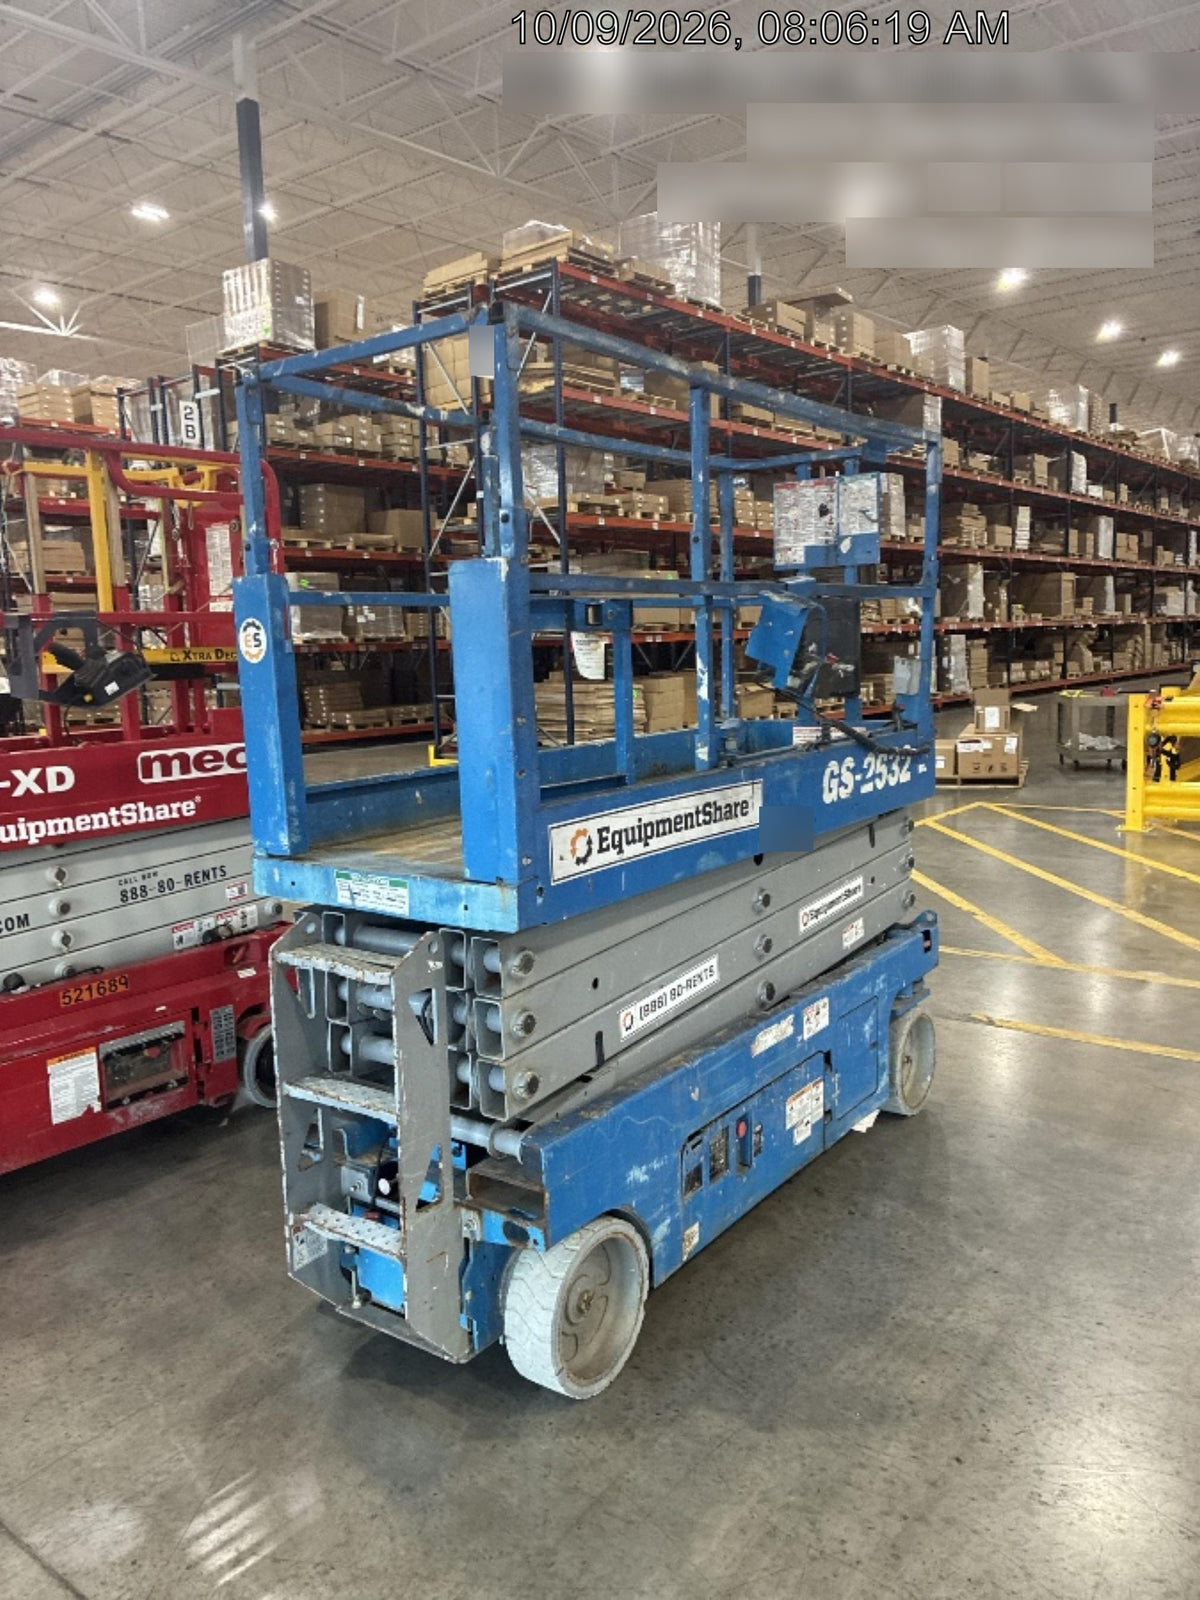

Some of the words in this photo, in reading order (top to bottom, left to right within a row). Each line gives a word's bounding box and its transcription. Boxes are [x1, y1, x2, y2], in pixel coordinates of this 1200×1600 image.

[822, 752, 912, 805] GS-2532
[596, 799, 749, 855] EquipmentShare
[120, 865, 227, 903] 888-80-RENTS
[62, 975, 129, 1005] 521689
